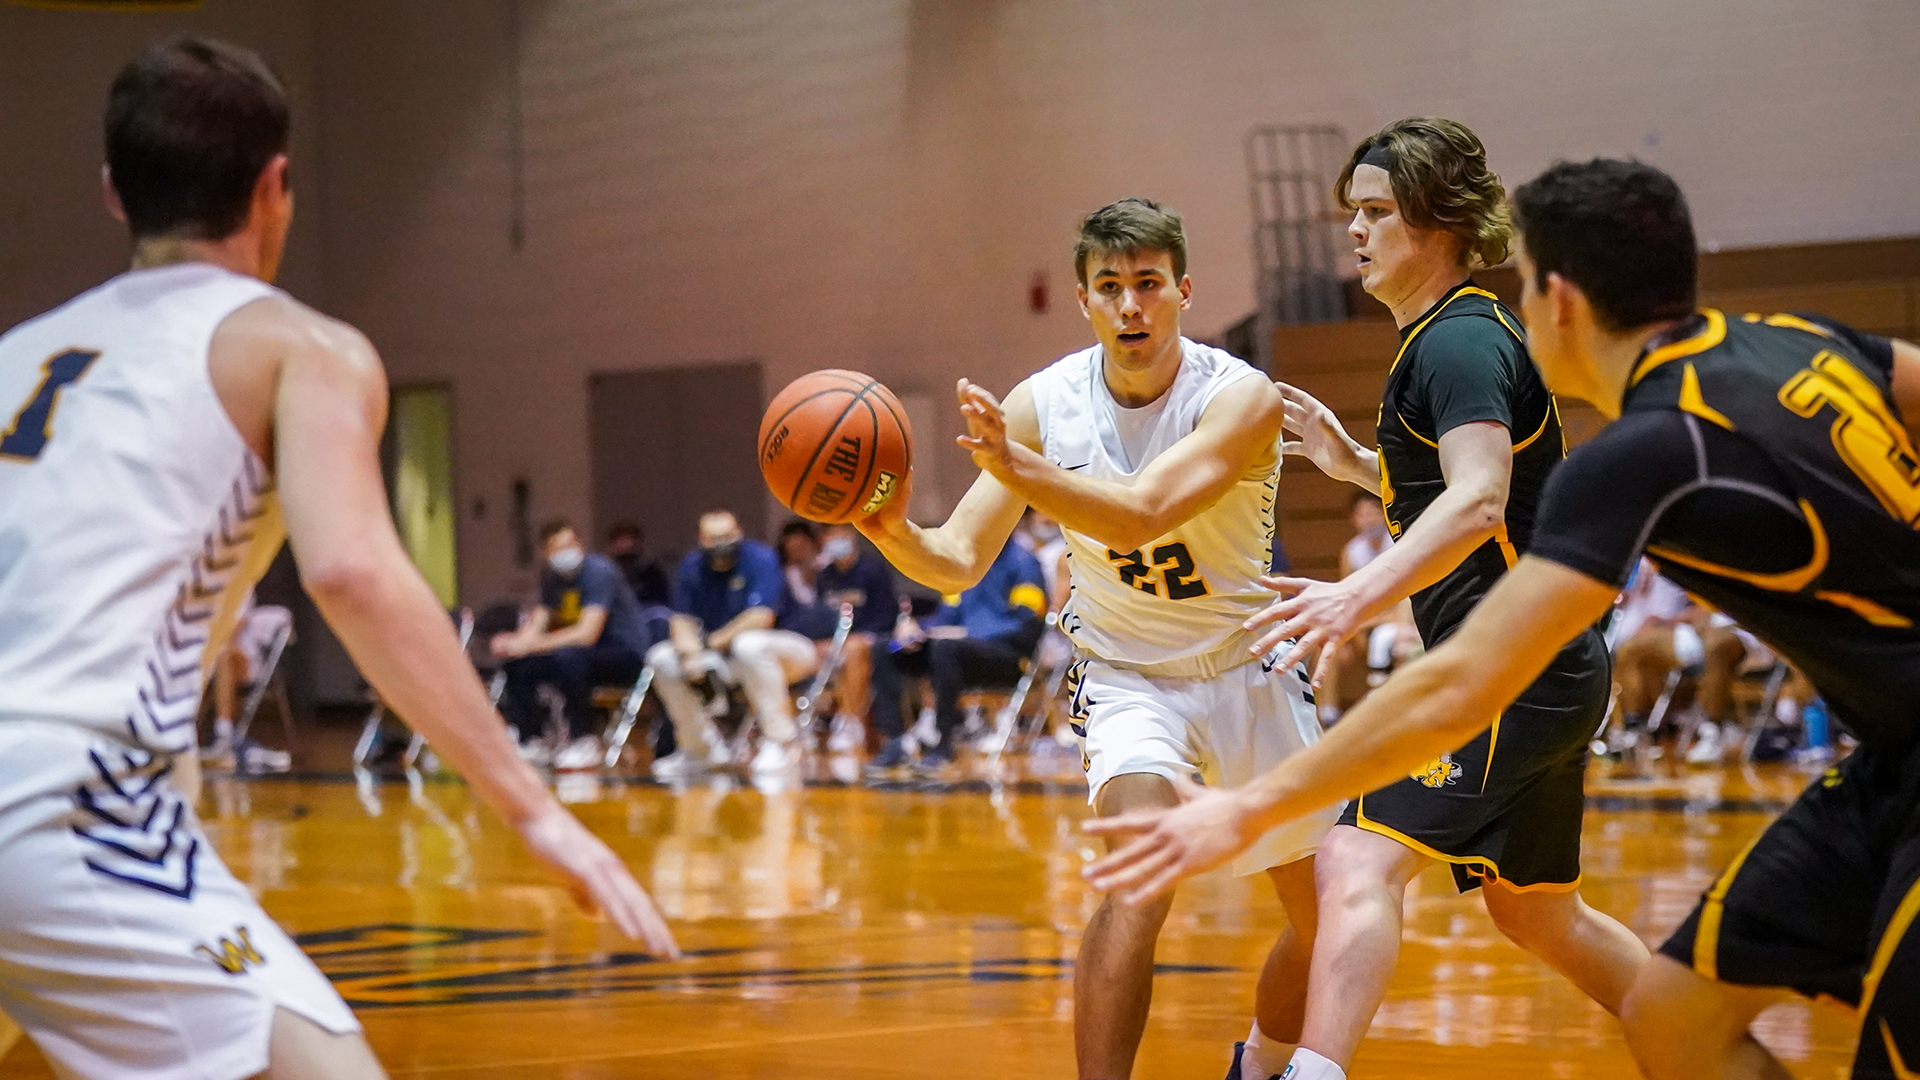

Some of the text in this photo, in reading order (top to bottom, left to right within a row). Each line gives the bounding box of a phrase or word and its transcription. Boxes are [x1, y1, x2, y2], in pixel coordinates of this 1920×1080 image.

[0, 347, 103, 463] 1
[823, 435, 862, 483] THE
[1105, 540, 1211, 601] 22
